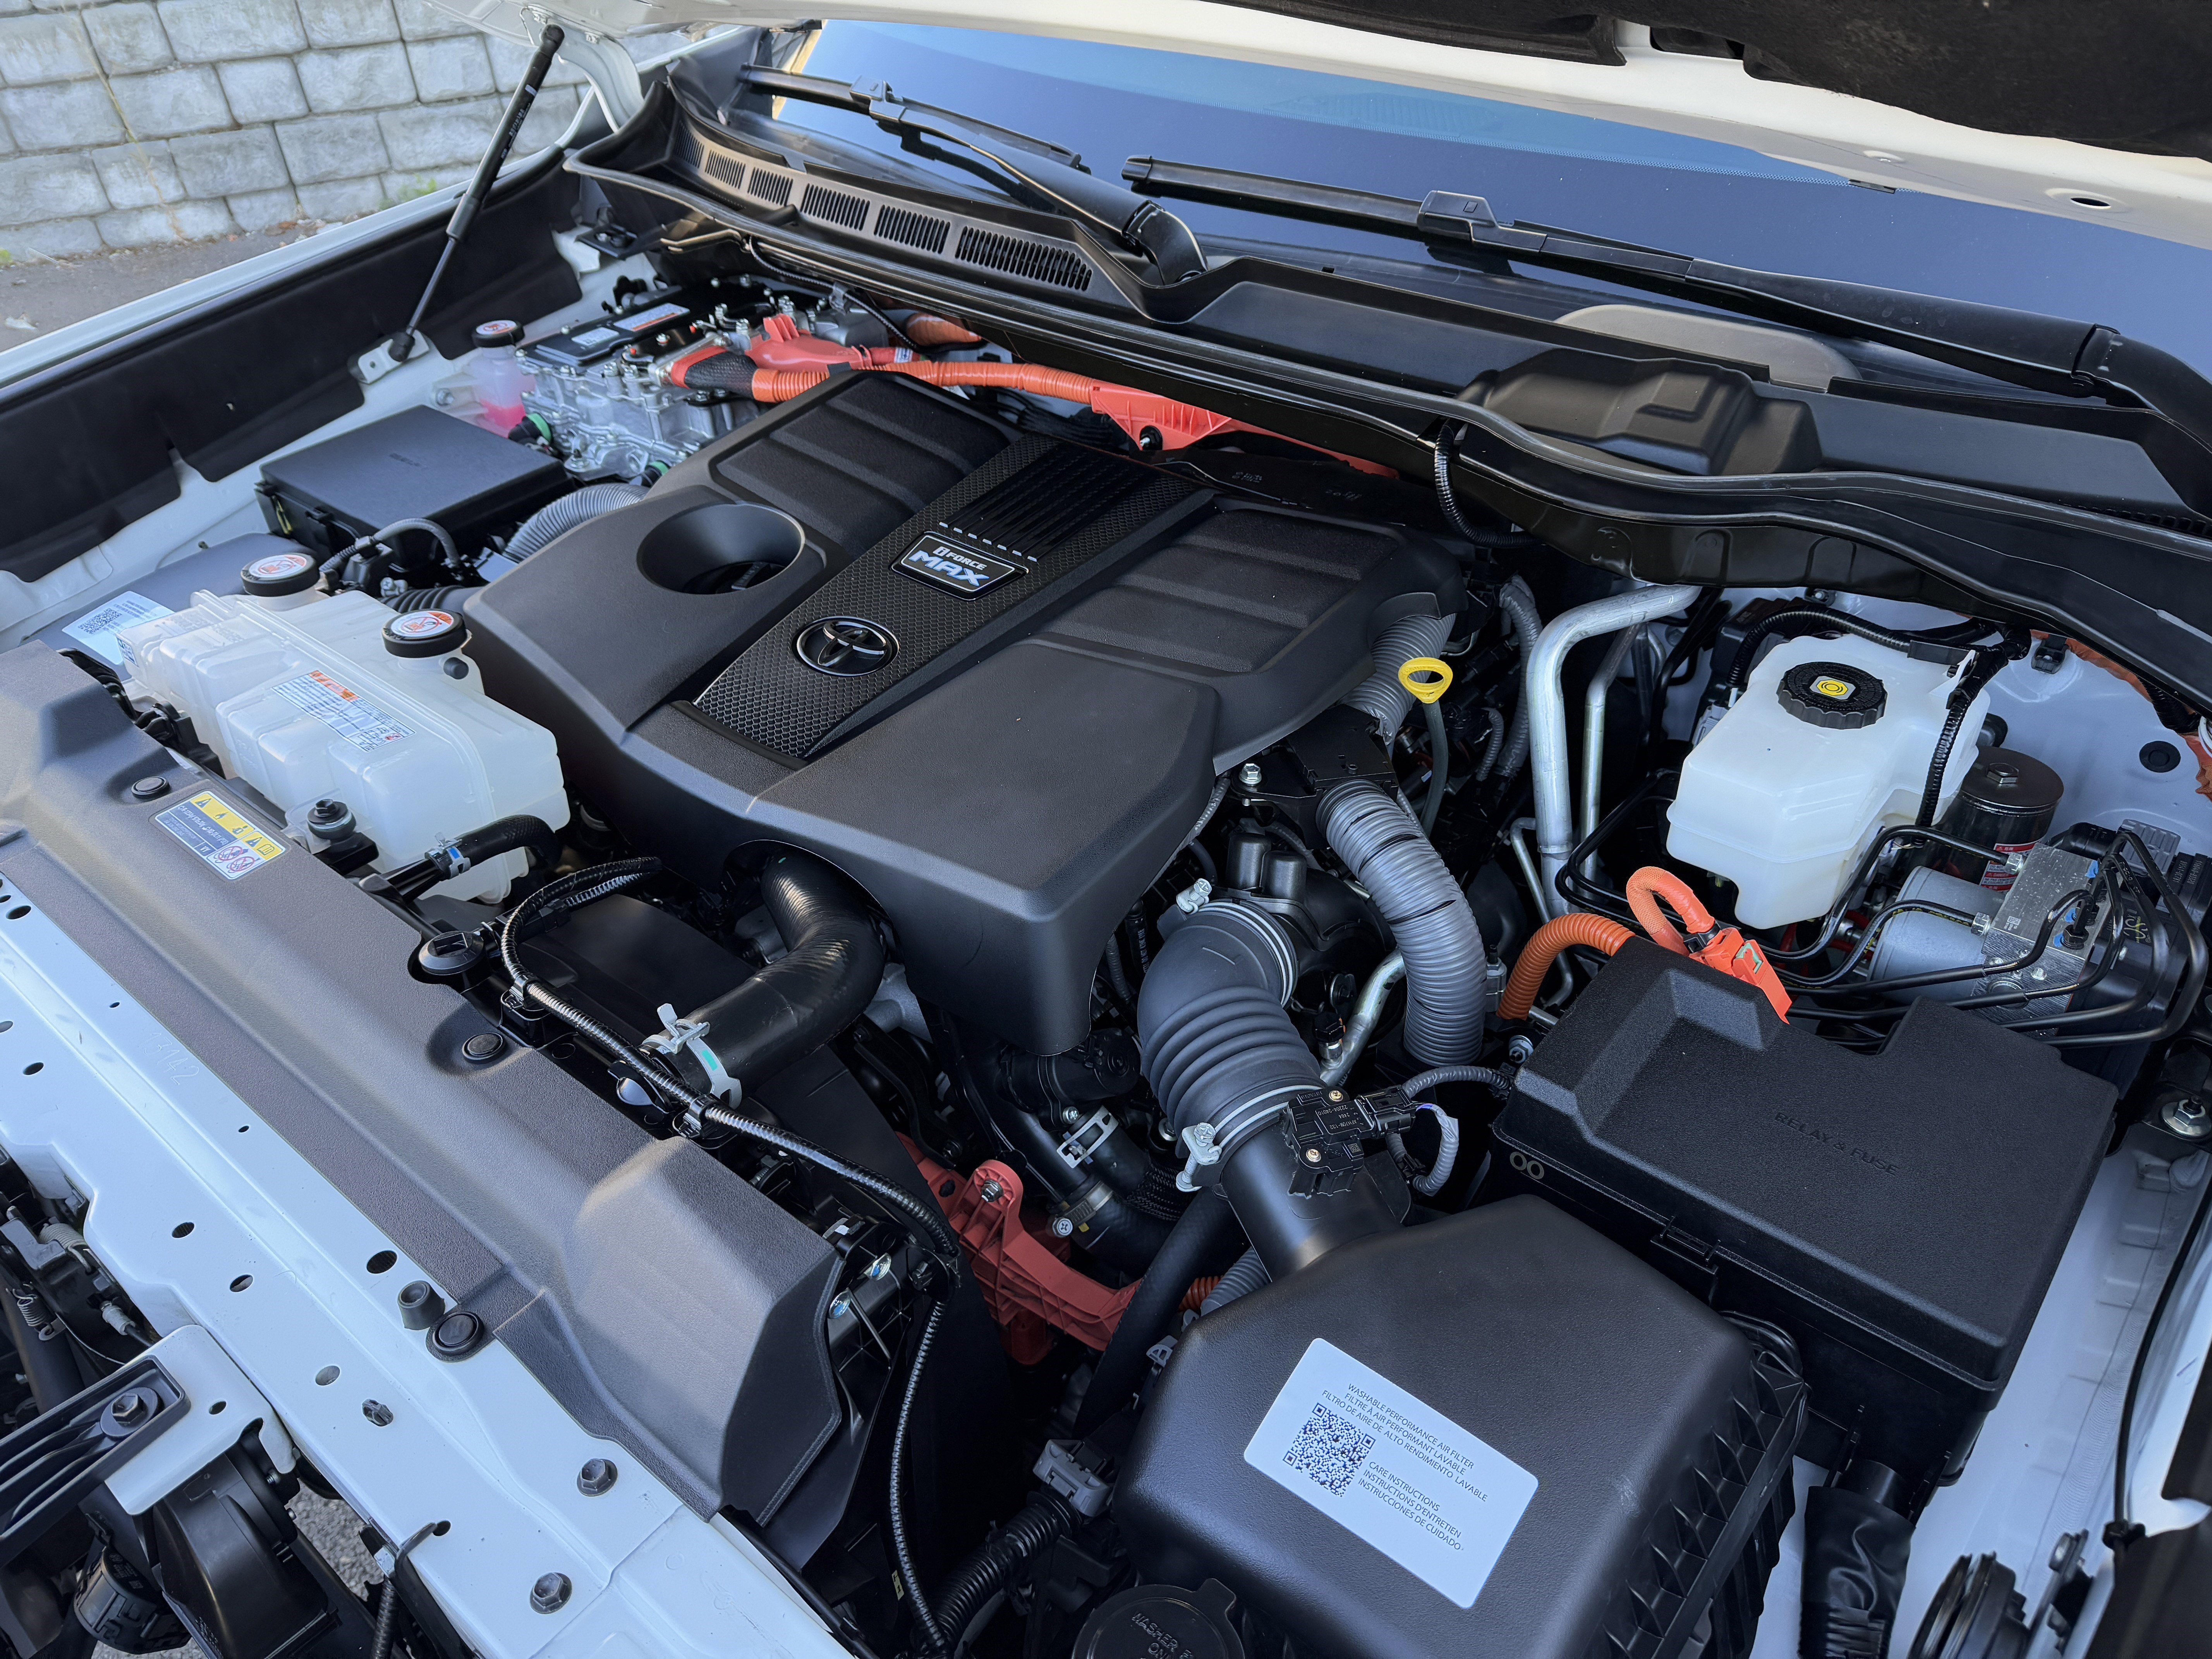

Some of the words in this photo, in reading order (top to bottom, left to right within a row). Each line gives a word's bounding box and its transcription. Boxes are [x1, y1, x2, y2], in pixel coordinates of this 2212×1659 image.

[908, 550, 989, 586] MAX
[1774, 1112, 1833, 1143] RELAY
[1833, 1141, 1846, 1152] &
[1850, 1147, 1901, 1176] FUSE
[1322, 1390, 1345, 1408] FILTRO
[1345, 1405, 1357, 1415] DE
[1355, 1412, 1373, 1425] AIRE
[1372, 1422, 1384, 1432] DE
[1383, 1431, 1403, 1445] ALTO
[1404, 1443, 1453, 1477] RENDIMIENTO
[1455, 1476, 1487, 1501] LAVABLE
[1344, 1393, 1368, 1411] FILTRE
[1366, 1406, 1372, 1415] À
[1372, 1412, 1386, 1423] AIR
[1385, 1419, 1434, 1453] PERFORMANT
[1433, 1450, 1466, 1475] LAVABLE
[1348, 1383, 1386, 1411] WASHABLE
[1385, 1408, 1438, 1445] PERFORMANCE
[1437, 1442, 1450, 1453] AIR
[1450, 1449, 1474, 1469] FILTER
[1358, 1478, 1415, 1518] INSTRUCCIONES
[1414, 1515, 1426, 1527] DE
[1425, 1523, 1460, 1549] CUIDADO
[1363, 1469, 1415, 1506] INSTRUCTIONS
[1414, 1503, 1461, 1538] D'ENTRETIEN
[1369, 1462, 1388, 1477] CARE
[1388, 1473, 1440, 1511] INSTRUCTIONS
[1132, 1611, 1178, 1652] WASHER
